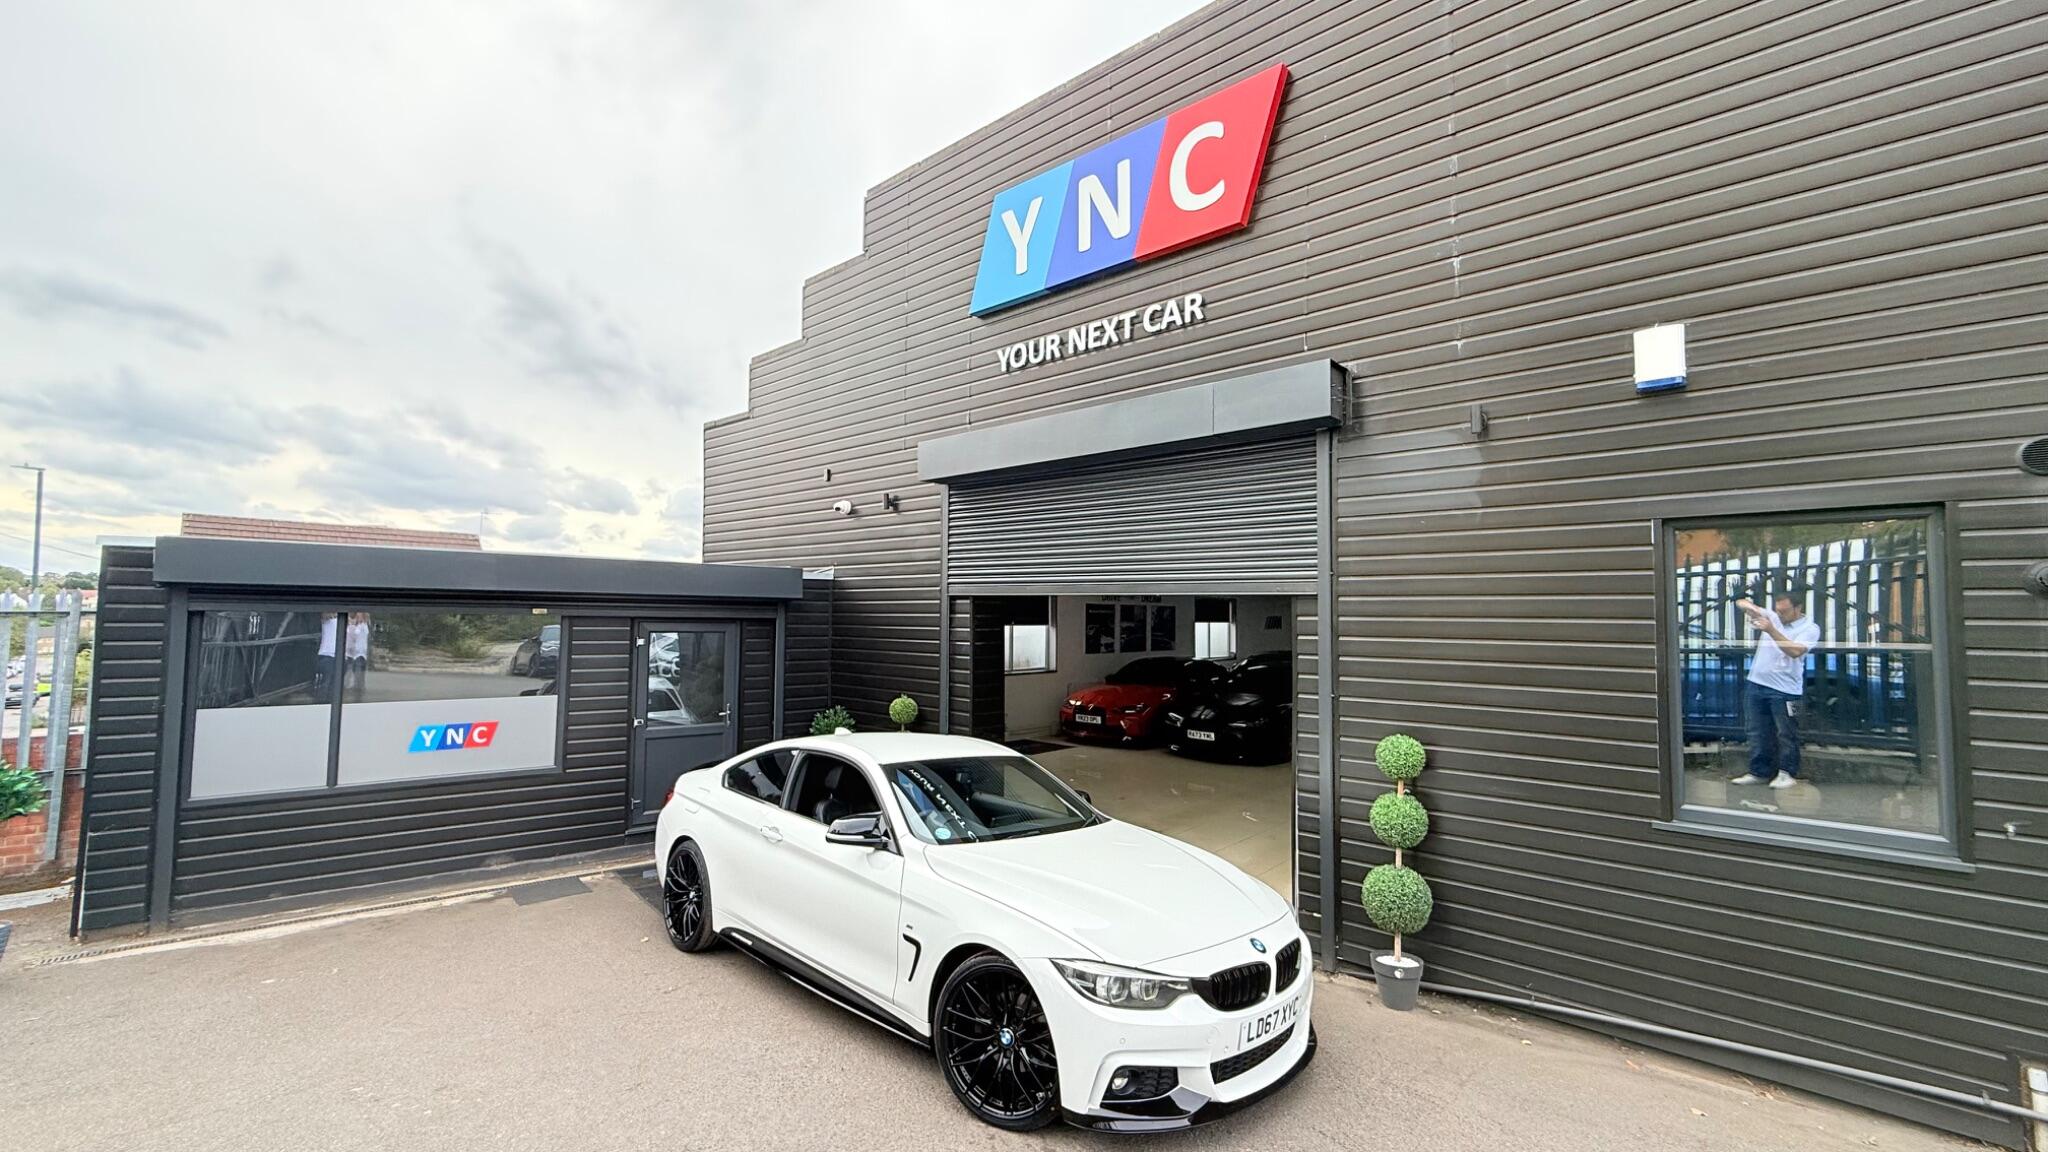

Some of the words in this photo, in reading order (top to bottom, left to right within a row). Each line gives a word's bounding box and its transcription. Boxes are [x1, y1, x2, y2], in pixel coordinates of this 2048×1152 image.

[1001, 120, 1225, 276] YNC
[996, 334, 1061, 373] YOUR
[1067, 310, 1137, 354] NEXT
[1142, 292, 1204, 333] CAR
[420, 726, 488, 747] YNC
[1247, 1009, 1280, 1043] LD67
[1280, 996, 1299, 1026] XYC
